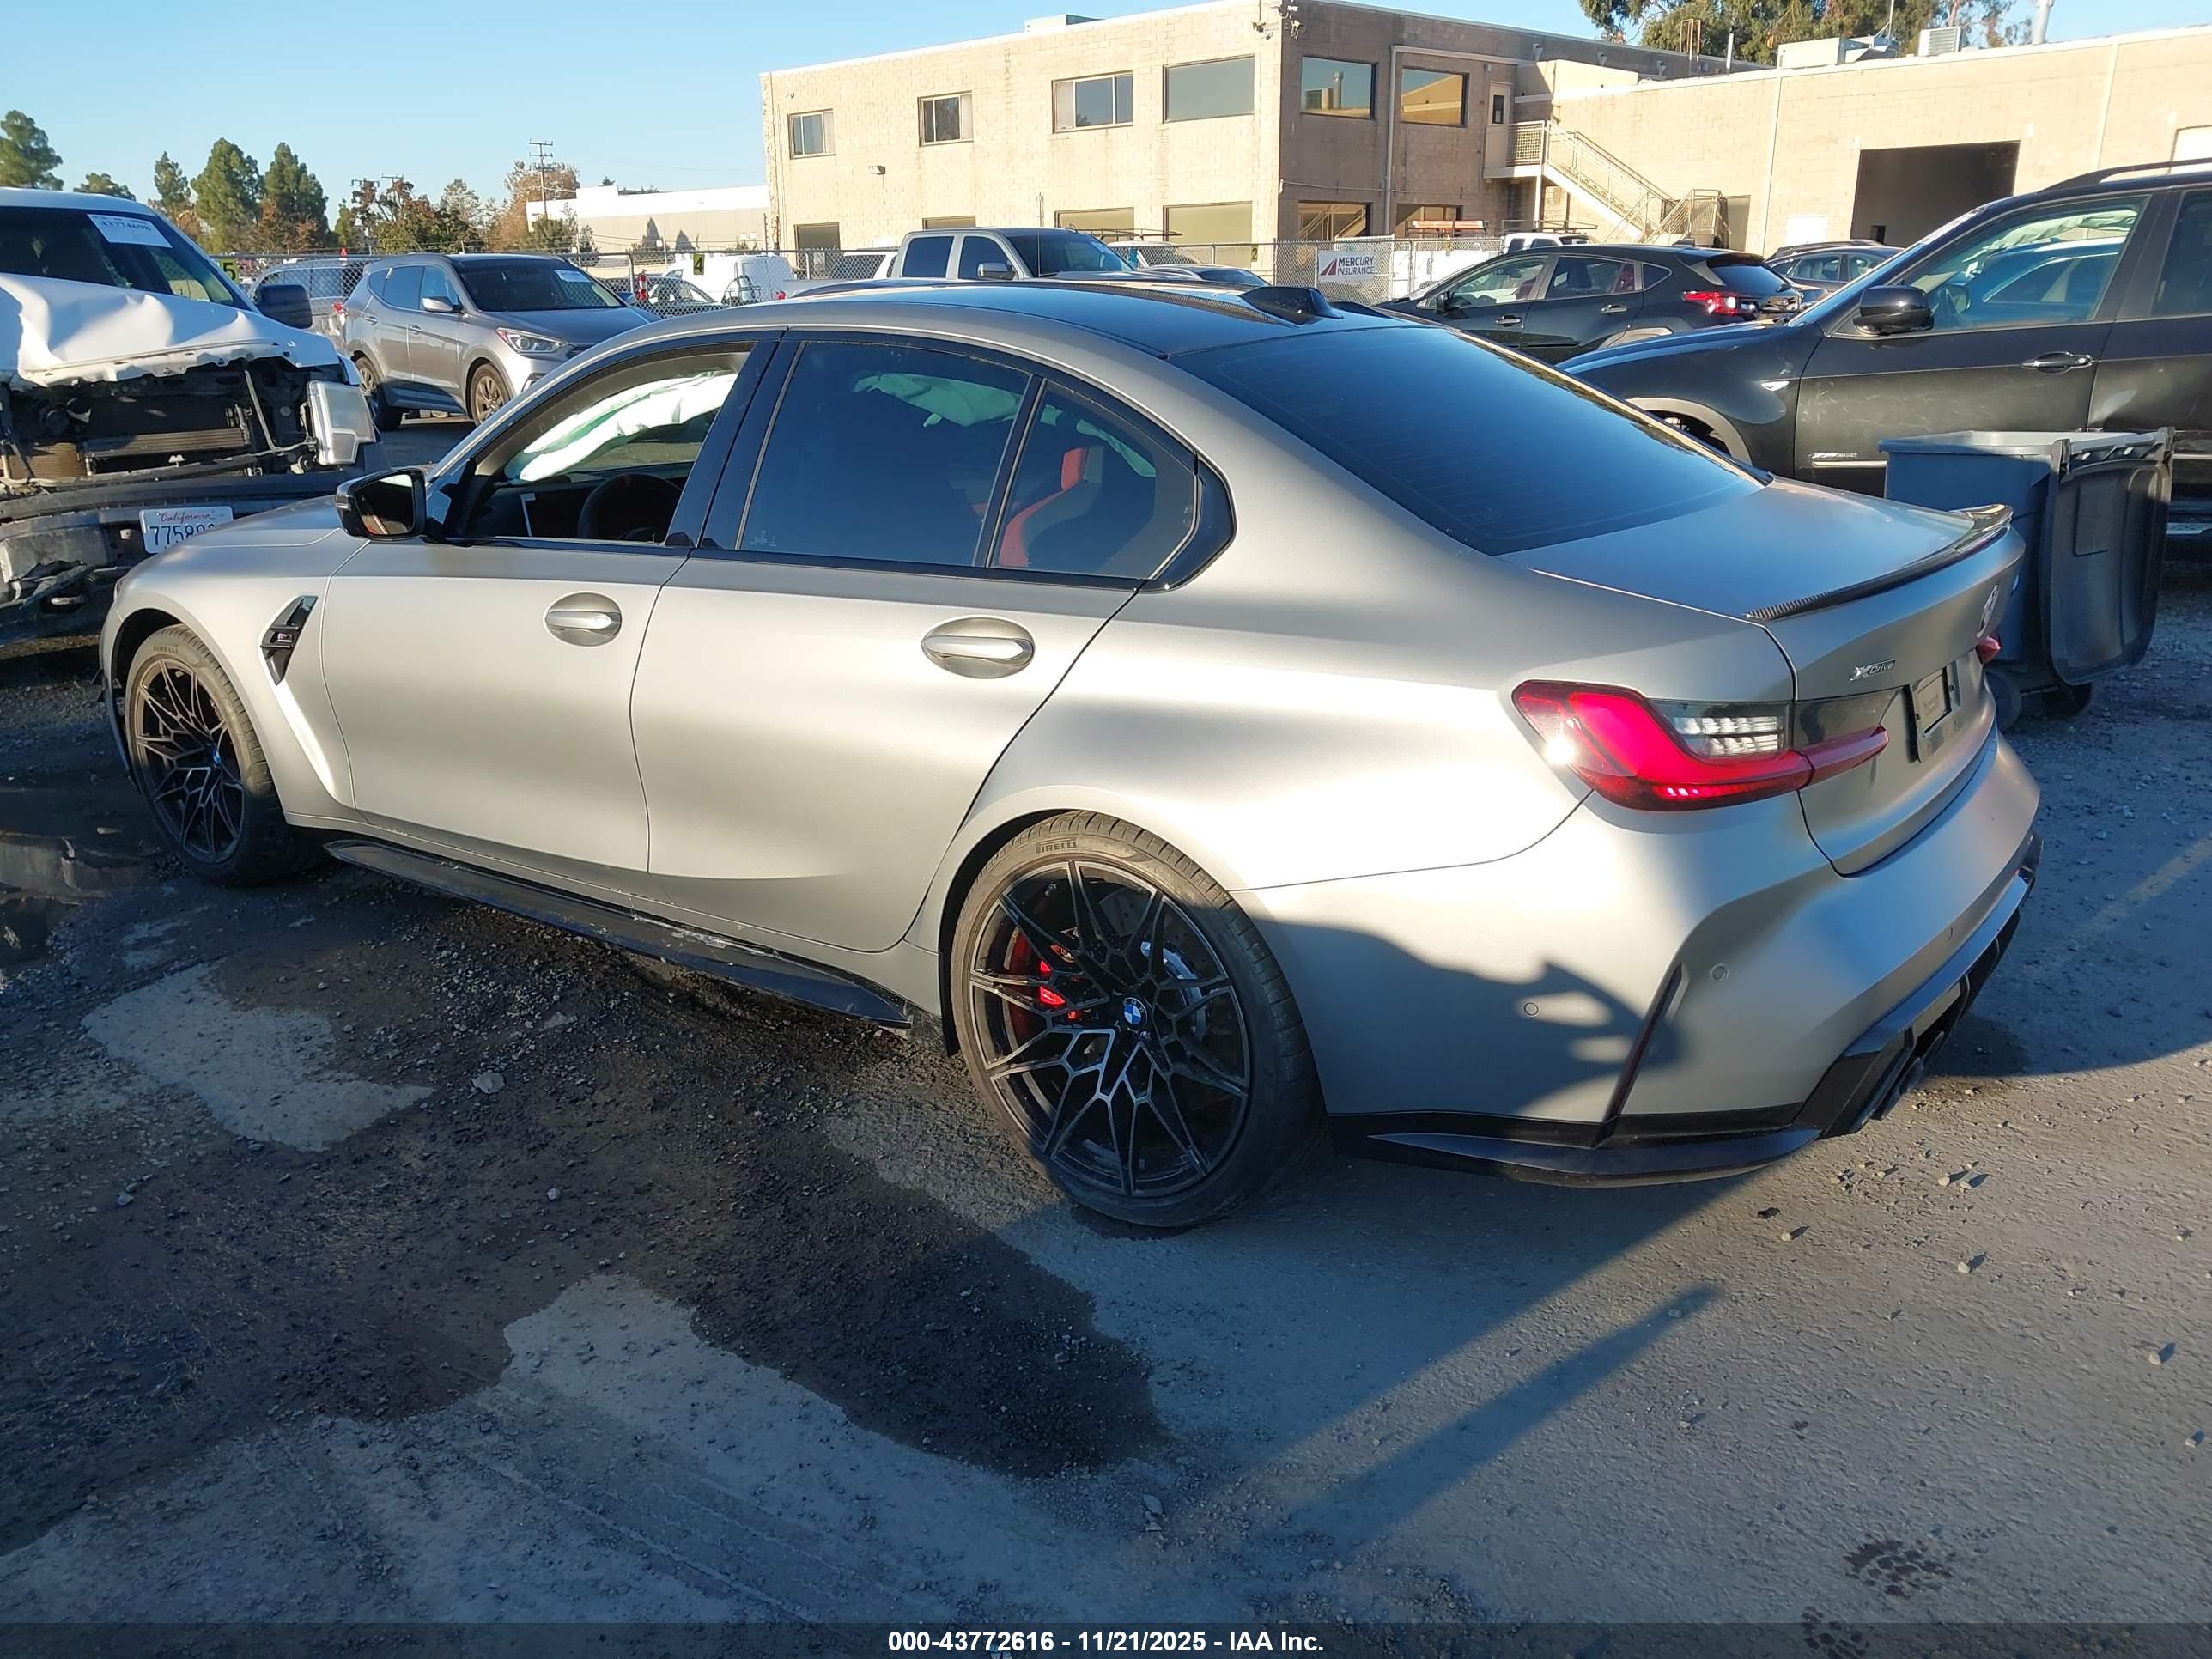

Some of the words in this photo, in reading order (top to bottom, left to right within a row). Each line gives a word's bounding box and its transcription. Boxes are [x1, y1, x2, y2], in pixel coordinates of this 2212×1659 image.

[1251, 247, 1258, 261] 2
[1339, 256, 1374, 266] MERCURY
[223, 262, 236, 281] 5
[694, 257, 704, 272] 4
[1337, 266, 1374, 276] INSURANCE
[161, 512, 210, 523] California
[1036, 837, 1077, 854] PIRELLI
